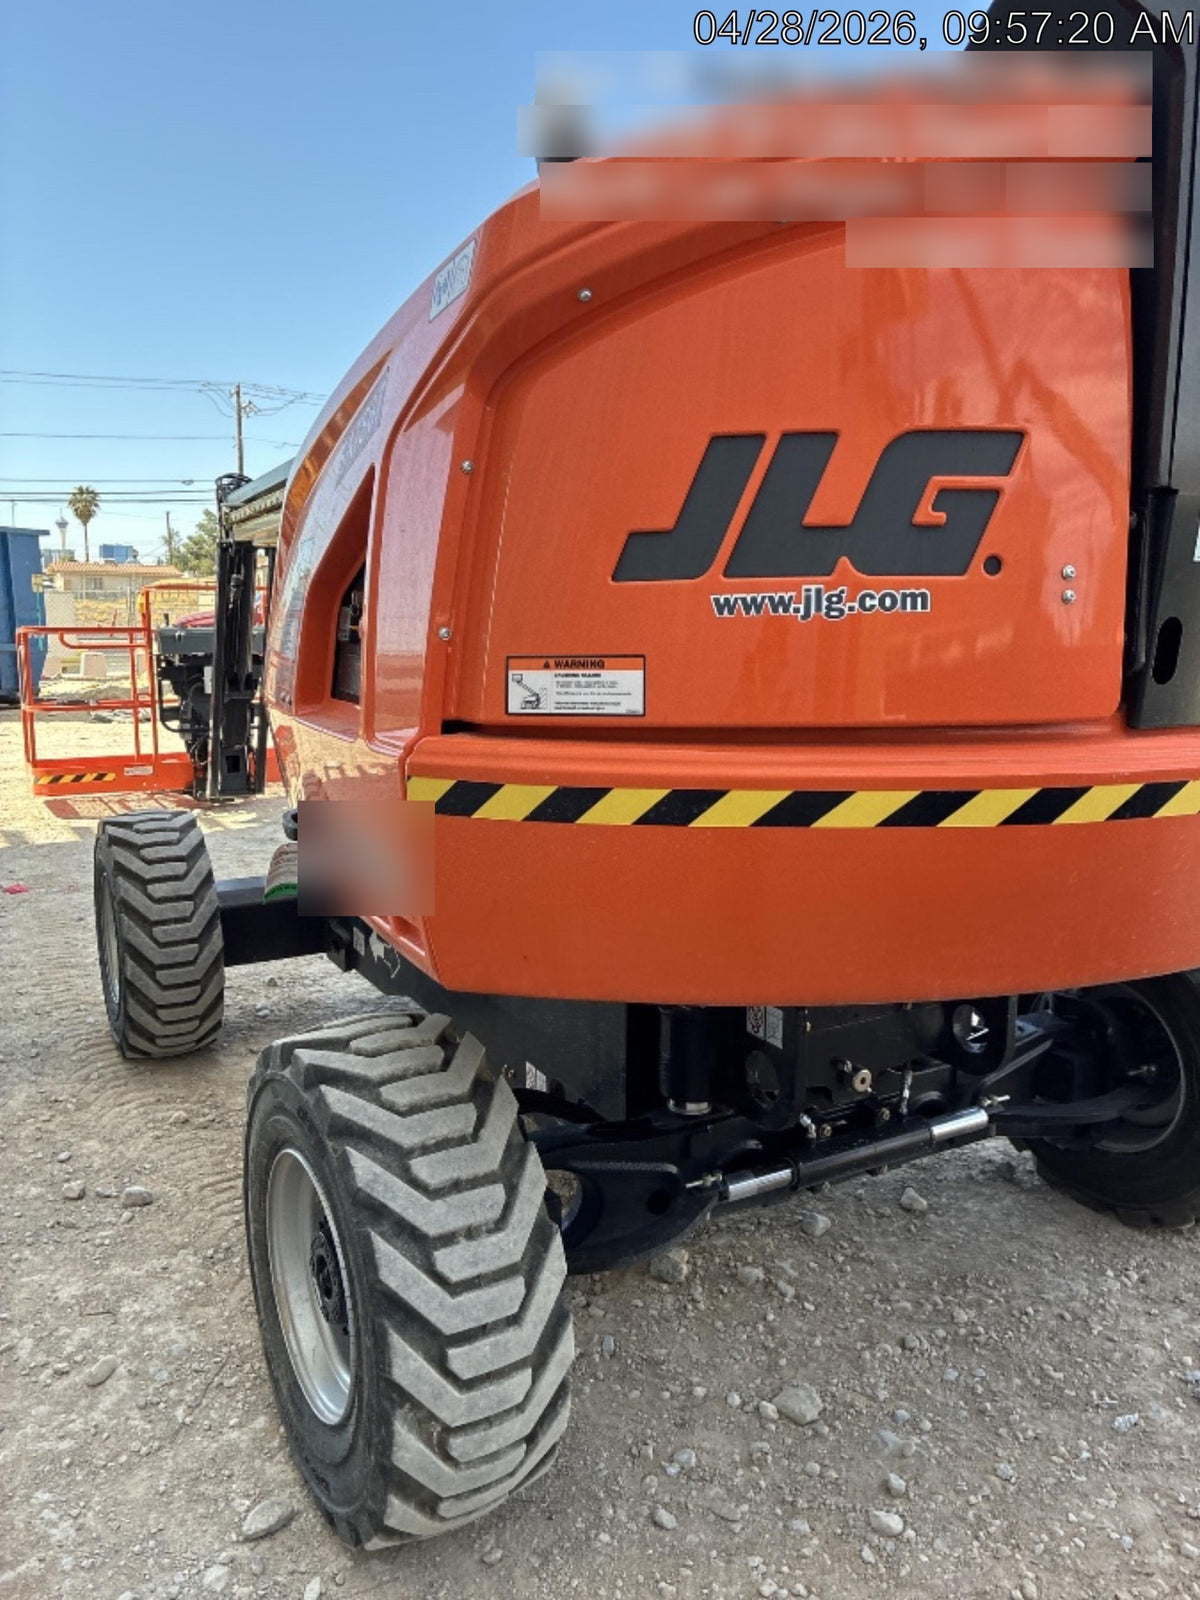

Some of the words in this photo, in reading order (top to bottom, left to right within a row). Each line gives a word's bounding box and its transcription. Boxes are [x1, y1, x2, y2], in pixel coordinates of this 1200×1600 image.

[612, 429, 1027, 582] JLG
[710, 585, 931, 621] www.jlg.com
[554, 658, 606, 669] WARNING
